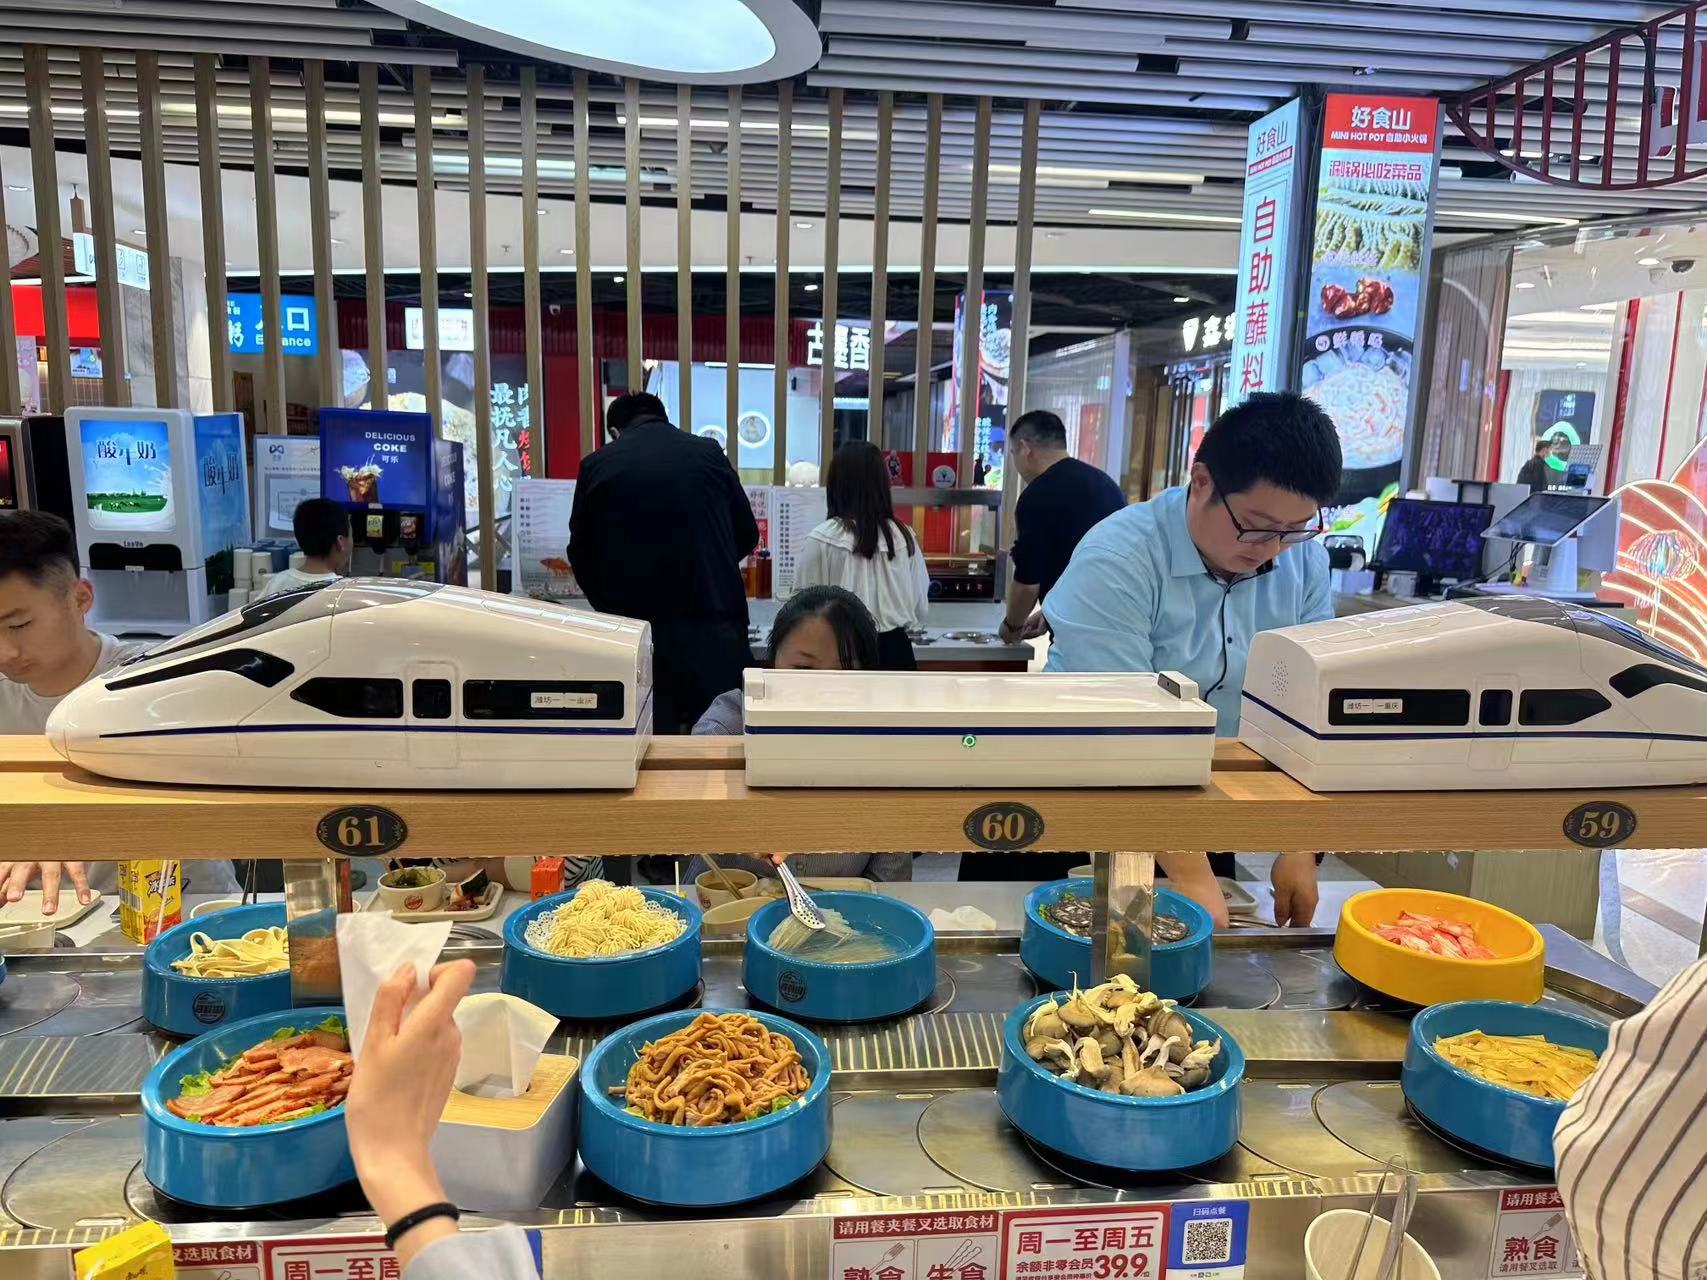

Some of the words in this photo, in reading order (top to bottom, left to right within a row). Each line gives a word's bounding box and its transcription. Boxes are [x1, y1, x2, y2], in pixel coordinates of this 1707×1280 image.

[1351, 105, 1411, 130] 好食山
[1256, 121, 1288, 157] 好食山
[1331, 131, 1349, 140] MINI
[1350, 132, 1368, 141] HOT
[1369, 133, 1385, 142] POT
[1329, 160, 1422, 181] 涮锅必吃菜品
[1240, 196, 1276, 394] 自助蘸料
[255, 333, 311, 347] Eance
[365, 431, 415, 442] DELICIOUS
[374, 443, 407, 452] COKE
[98, 440, 156, 465] 酸牛奶
[381, 455, 399, 464] 可乐
[204, 454, 239, 495] 酸牛奶
[338, 815, 384, 846] 61
[982, 813, 1025, 841] 60
[1579, 811, 1621, 839] 59
[1506, 1191, 1562, 1206] 请用餐夹
[1193, 1206, 1227, 1216] 扫码点餐
[839, 1214, 994, 1235] 请用餐夹餐叉选取食材
[1017, 1226, 1154, 1255] 周一至周五
[1503, 1236, 1559, 1262] 熟食
[1016, 1258, 1094, 1273] 余额非零会员
[1093, 1253, 1148, 1279] 39.9
[1499, 1261, 1558, 1273] 请用餐叉选取
